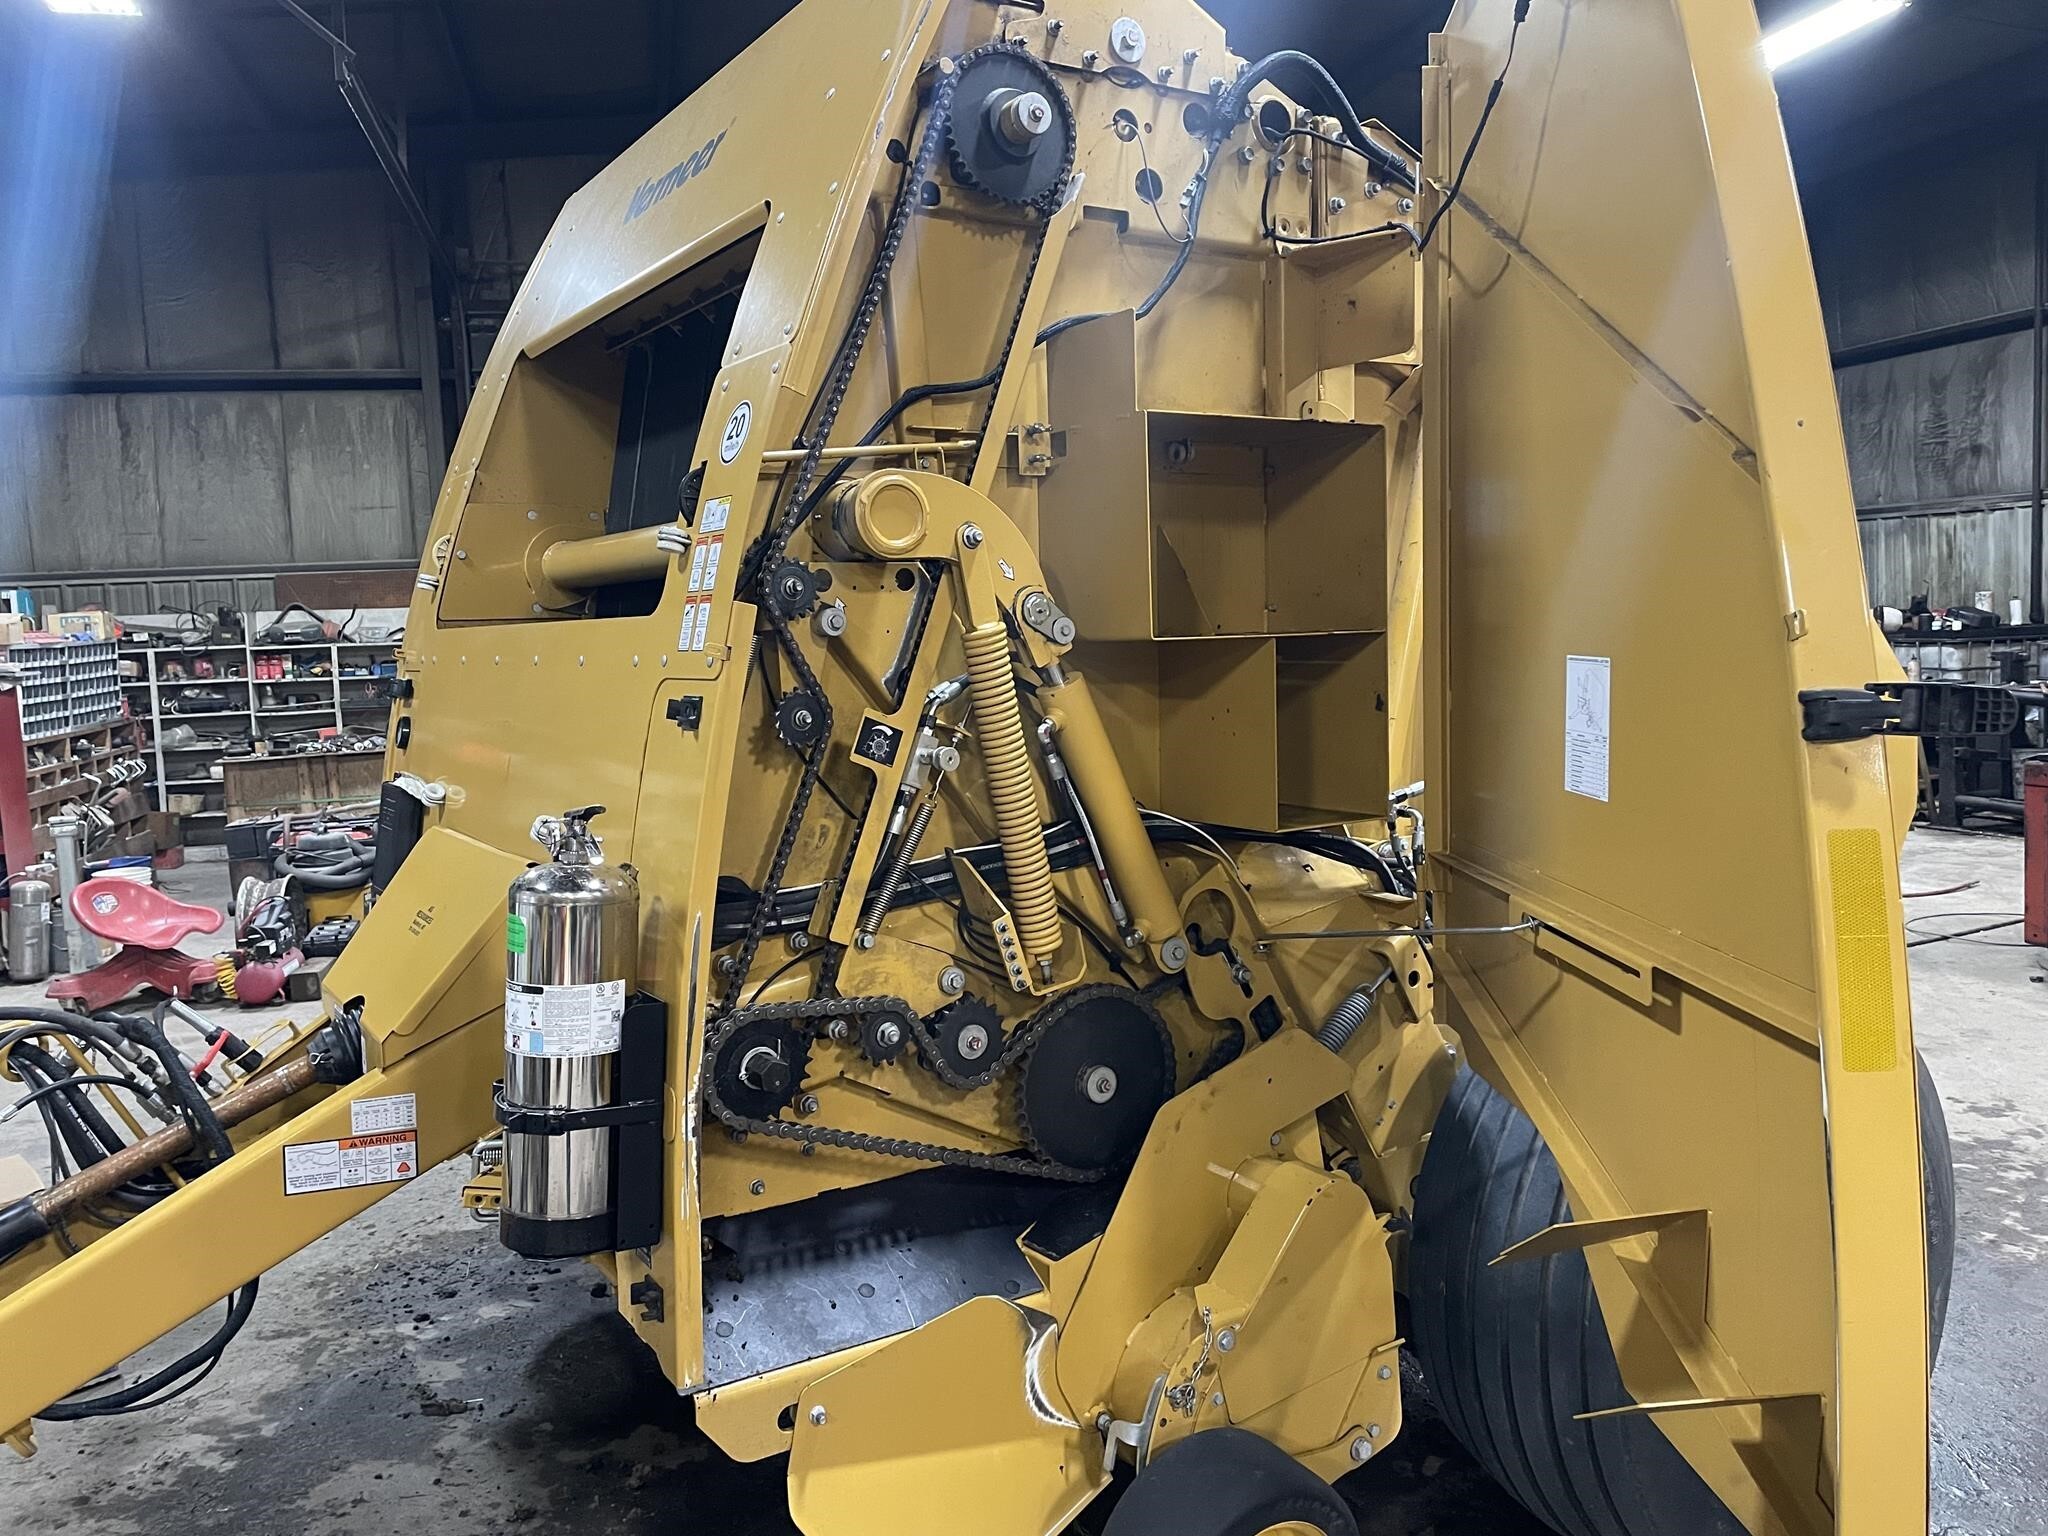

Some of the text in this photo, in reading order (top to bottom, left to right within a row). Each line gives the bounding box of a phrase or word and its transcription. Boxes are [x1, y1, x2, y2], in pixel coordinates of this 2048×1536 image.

[623, 128, 728, 225] Vermeer
[727, 413, 746, 441] 20
[359, 1134, 407, 1147] WARNING
